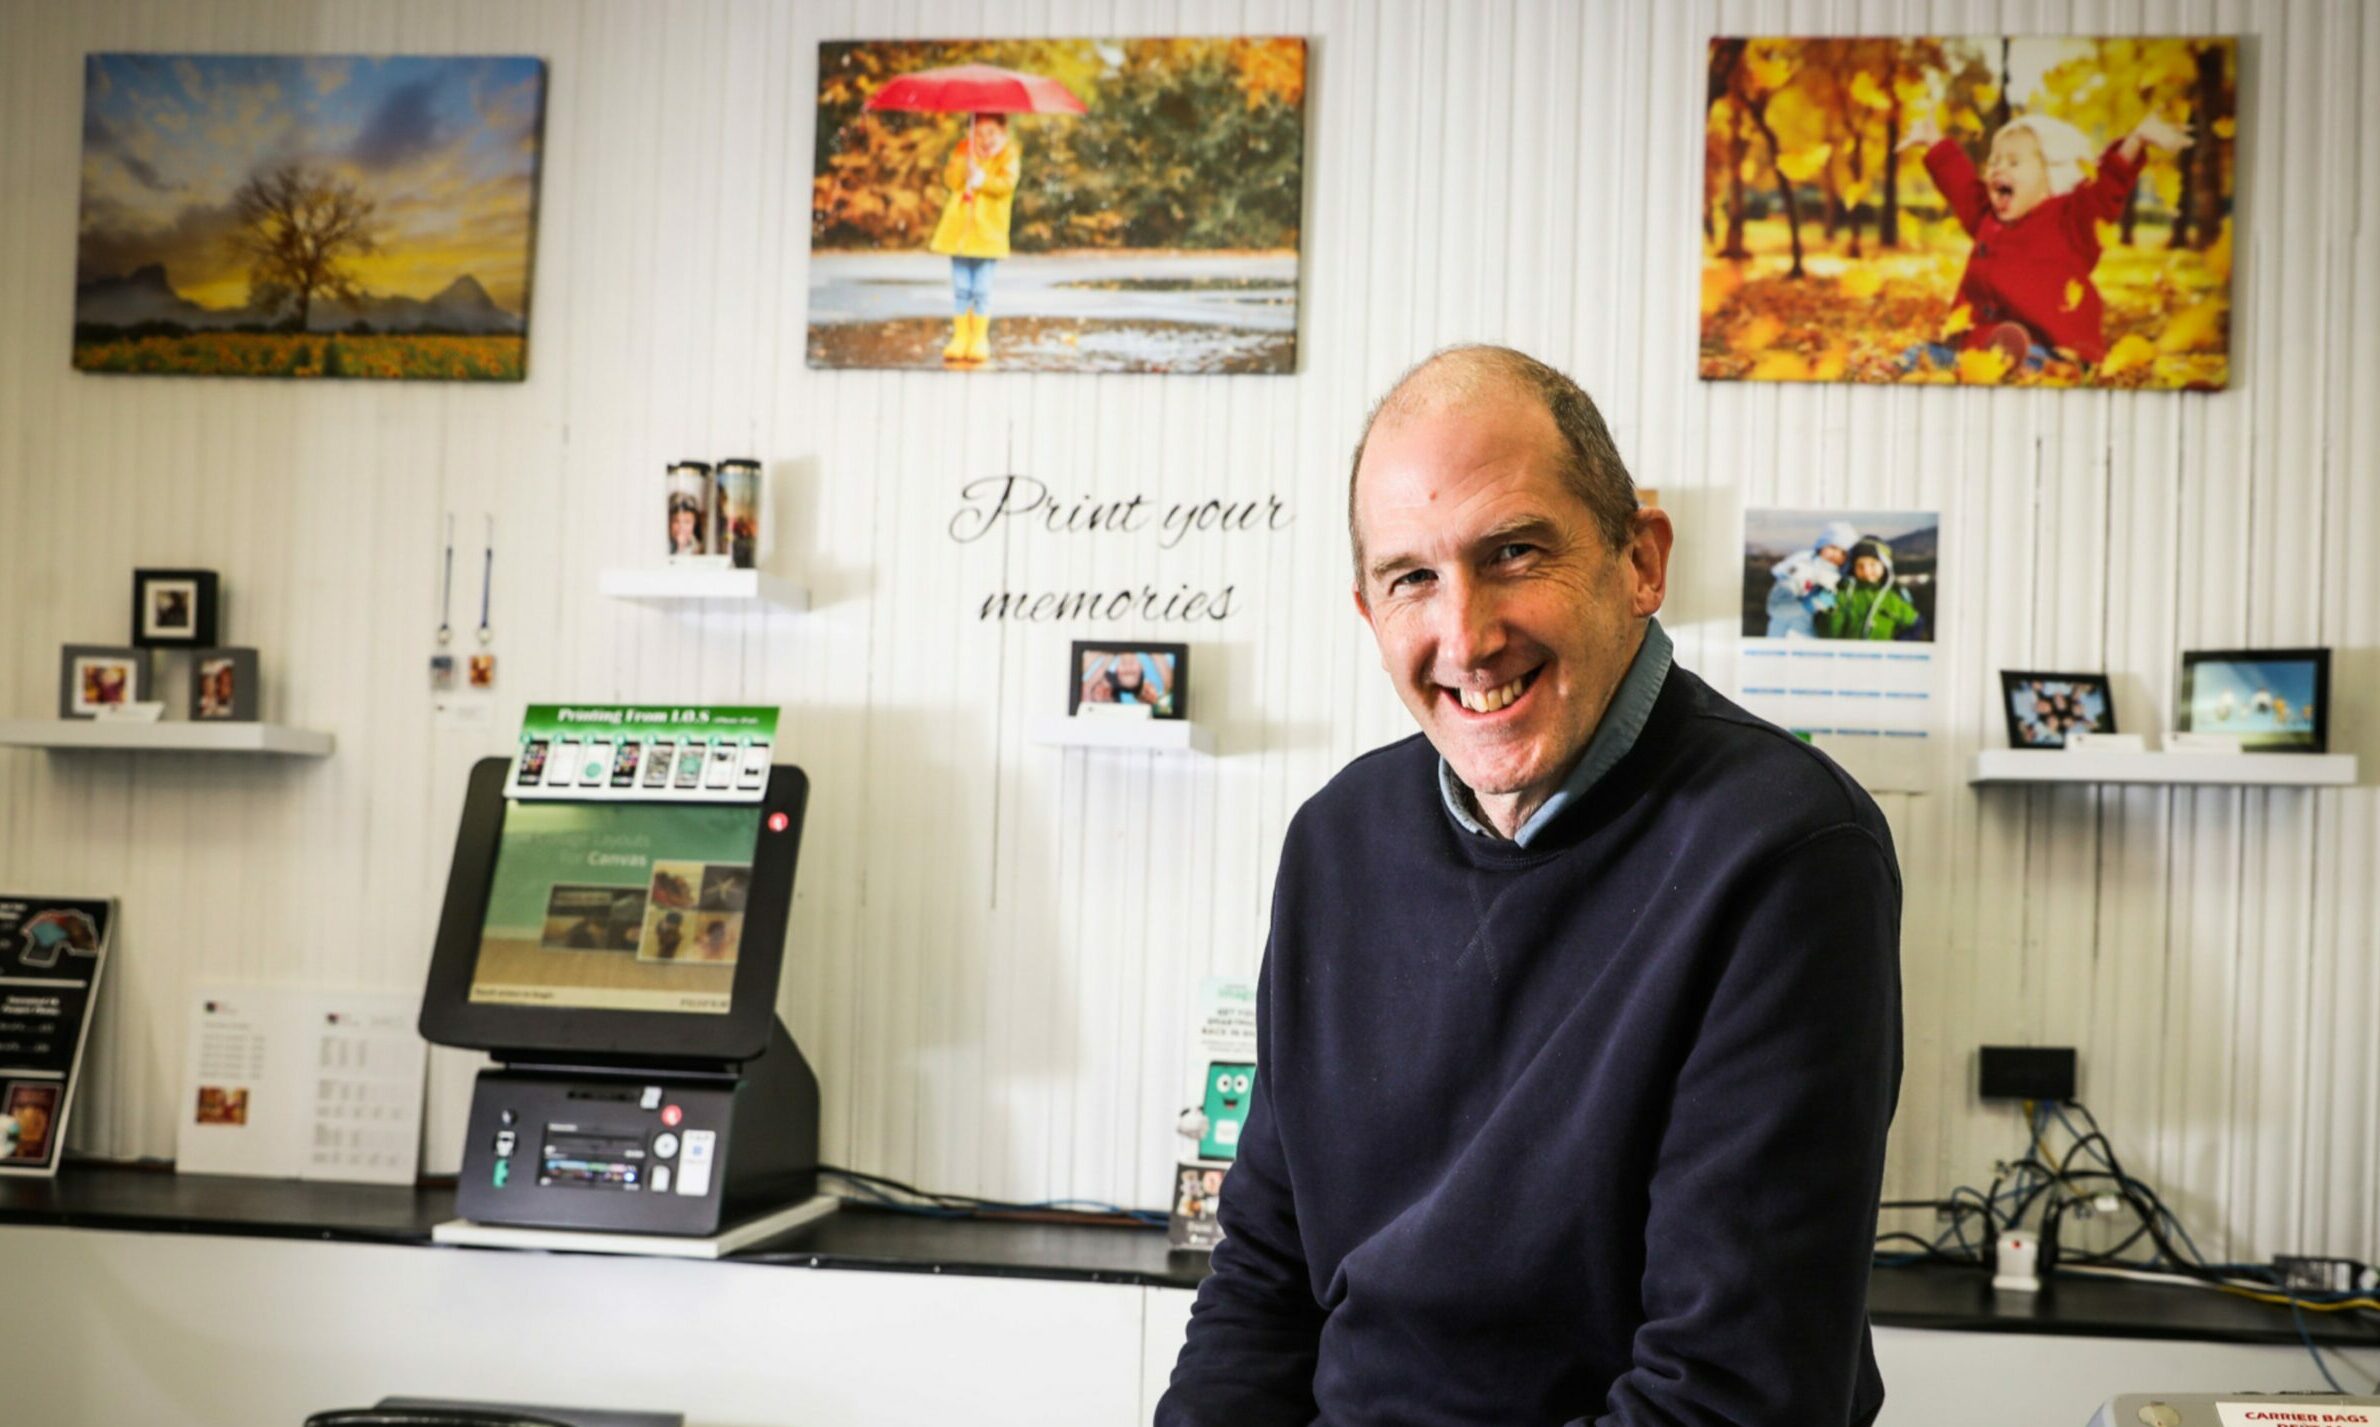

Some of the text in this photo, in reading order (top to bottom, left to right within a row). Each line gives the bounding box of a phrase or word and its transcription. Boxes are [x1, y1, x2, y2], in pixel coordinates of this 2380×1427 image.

[949, 474, 1297, 550] Print your
[979, 584, 1240, 622] memories
[558, 707, 622, 725] Printing
[624, 708, 668, 723] From
[587, 851, 647, 867] Canvas
[2244, 1411, 2369, 1423] CARRIER BAGS
